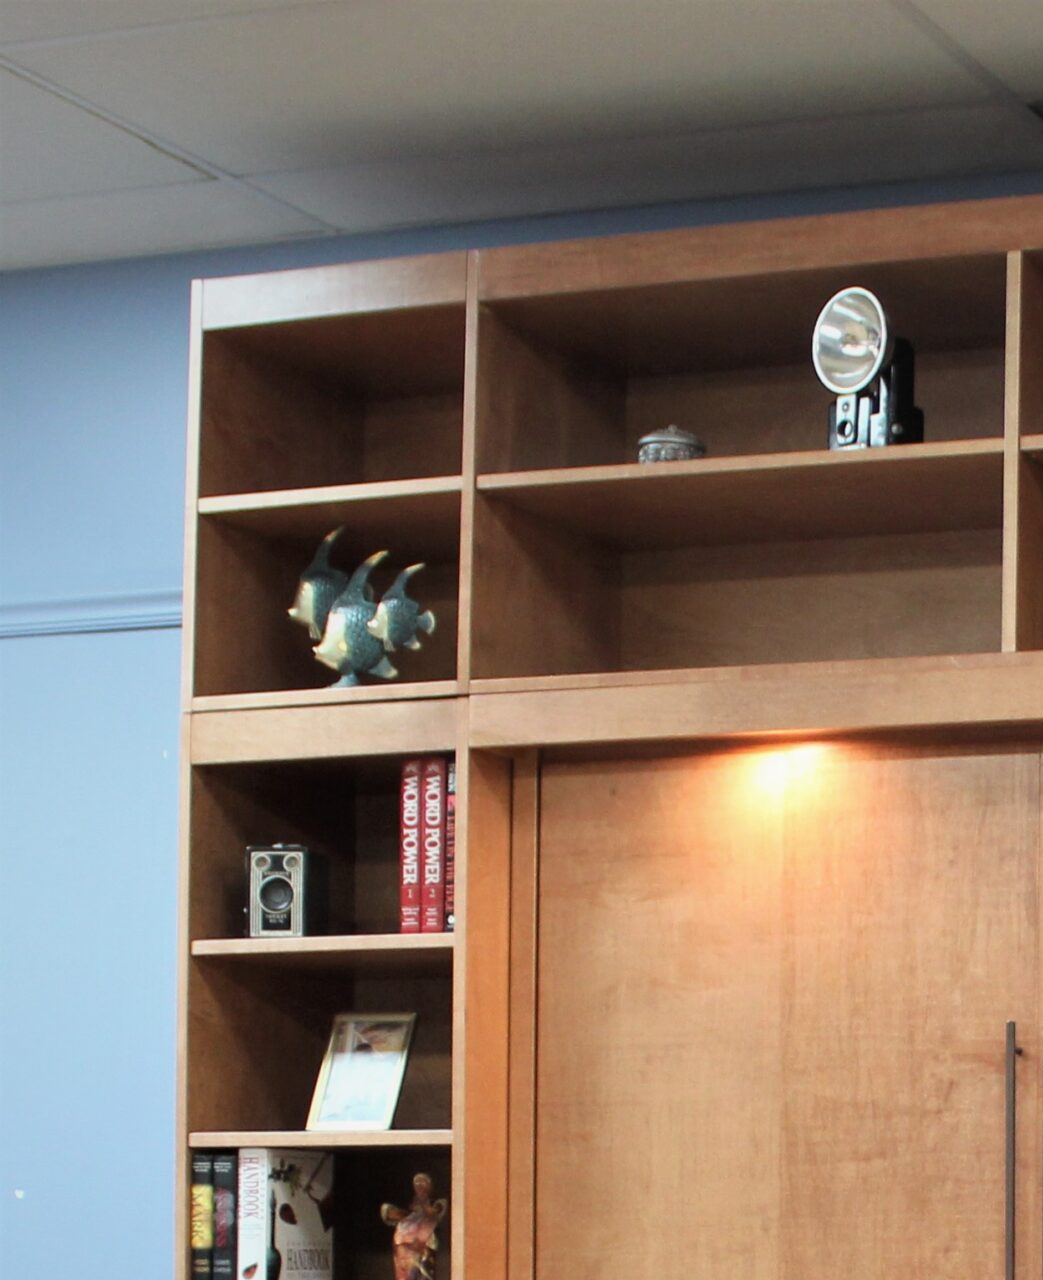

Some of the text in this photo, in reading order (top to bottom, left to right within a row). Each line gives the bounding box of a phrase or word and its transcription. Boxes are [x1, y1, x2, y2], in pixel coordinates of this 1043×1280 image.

[402, 776, 419, 885] WORD POWER
[424, 775, 441, 885] WORD POWER
[242, 1156, 260, 1218] HANDBOOK
